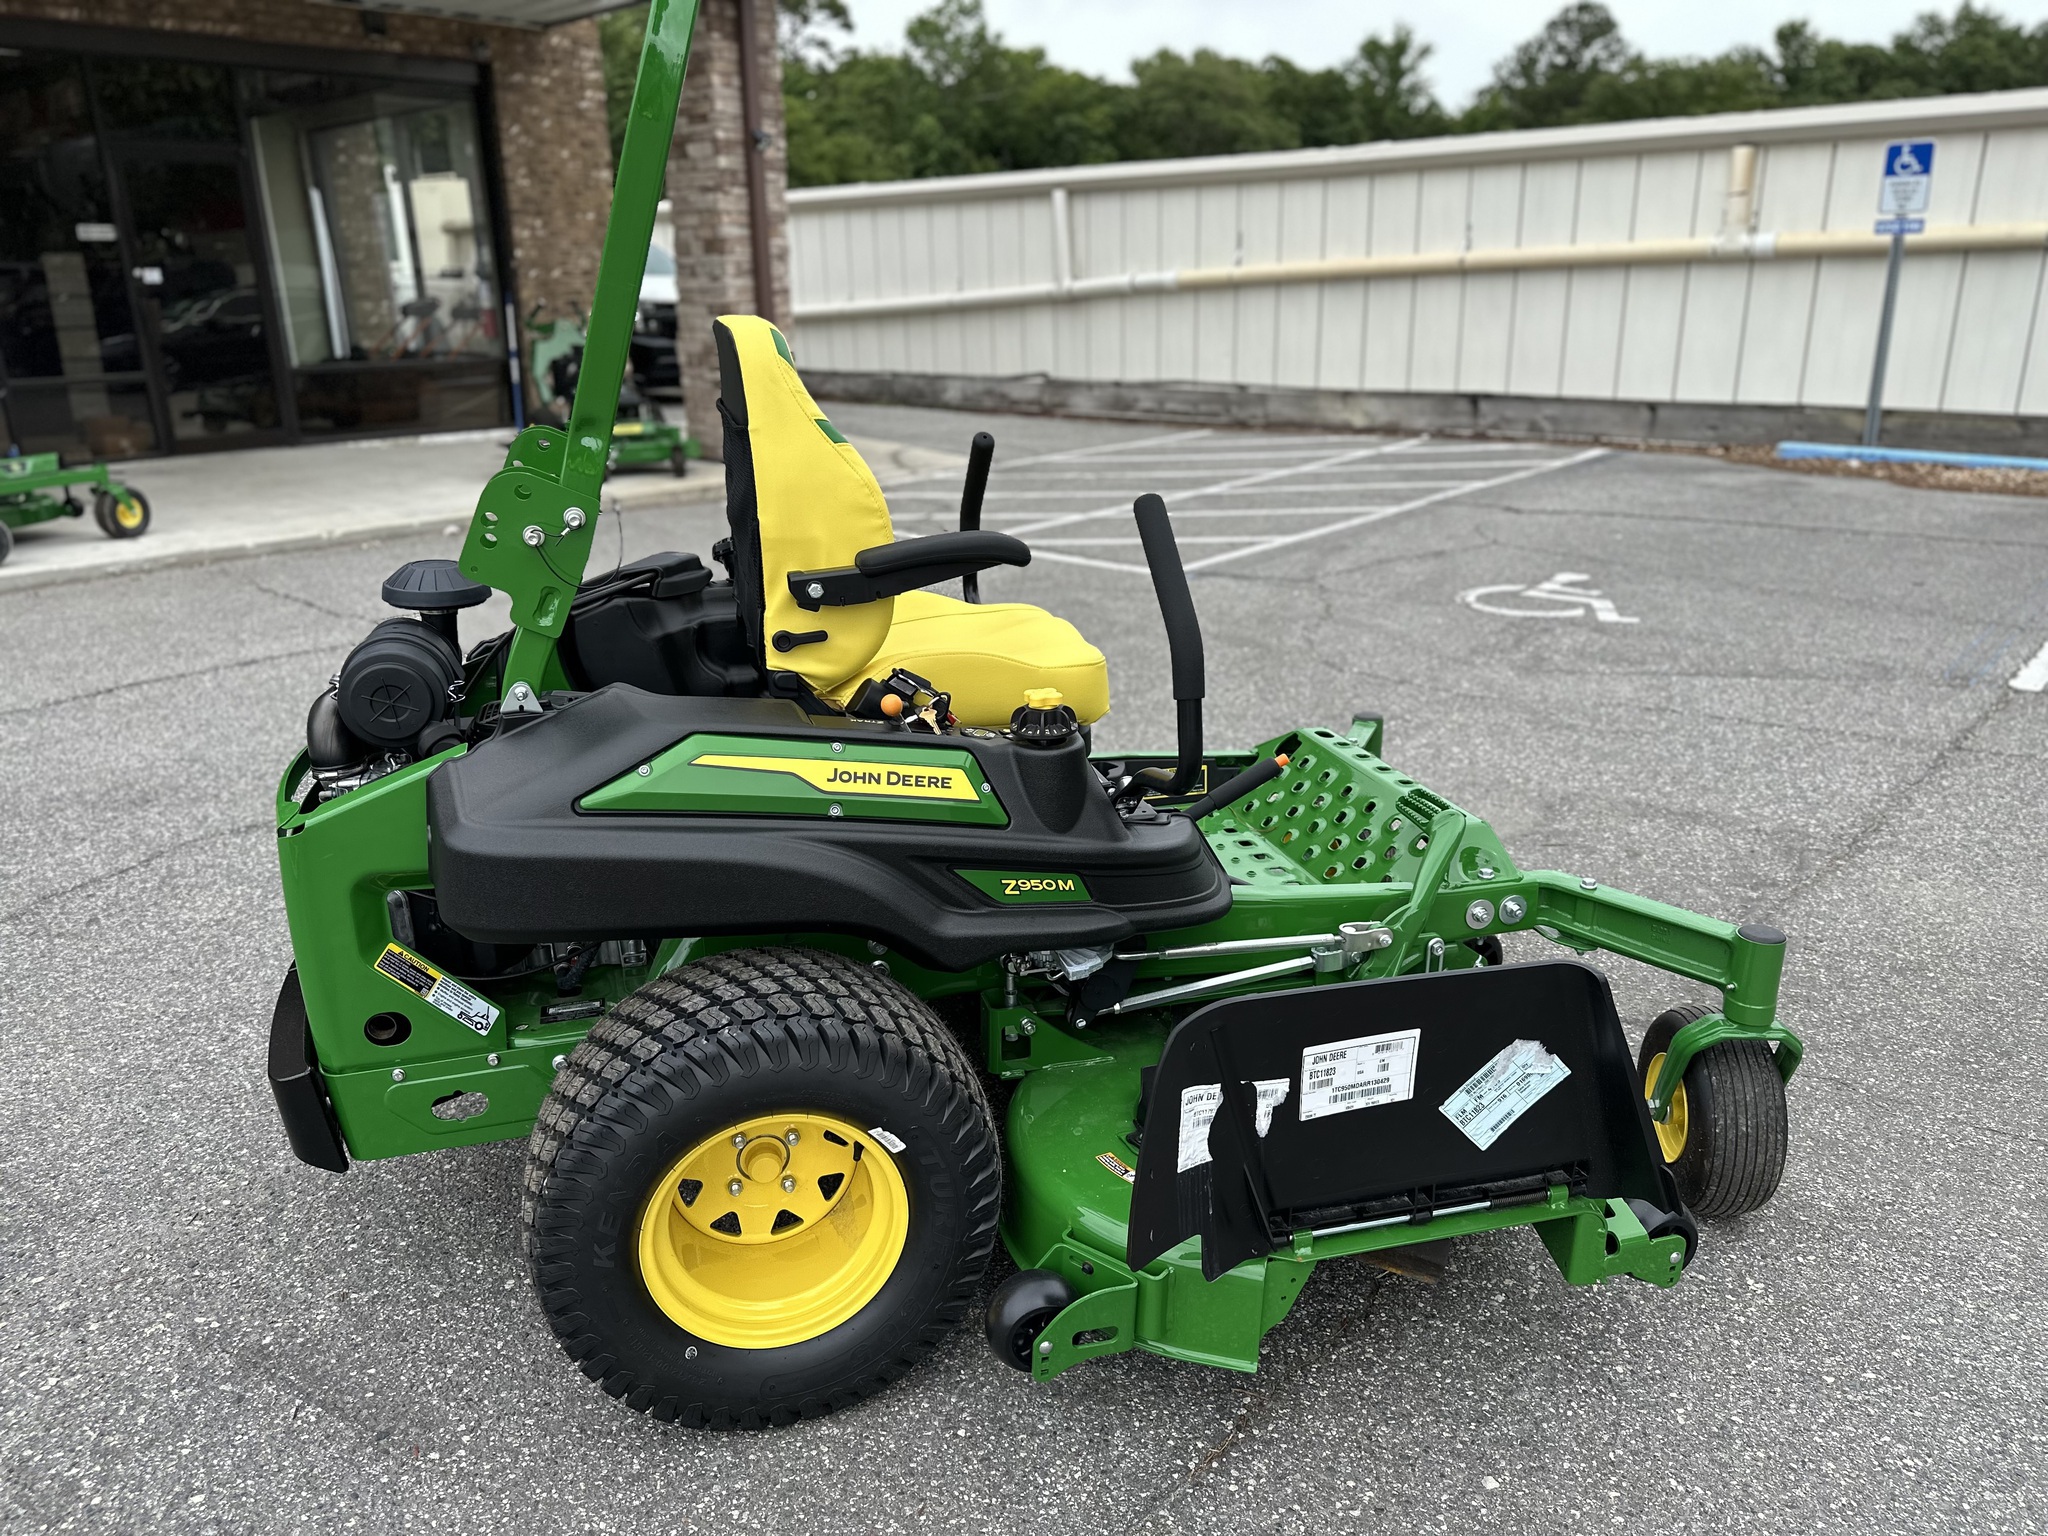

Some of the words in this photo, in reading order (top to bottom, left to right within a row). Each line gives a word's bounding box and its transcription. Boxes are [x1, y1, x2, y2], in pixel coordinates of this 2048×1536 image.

[826, 767, 882, 786] JOHN
[886, 771, 952, 789] DEERE
[1001, 877, 1075, 896] Z950M
[403, 953, 430, 973] CAUTION
[1311, 1053, 1329, 1066] JOHN
[1329, 1050, 1347, 1062] DEERE
[1309, 1066, 1337, 1080] BTC11823
[1185, 1093, 1205, 1106] JOHN
